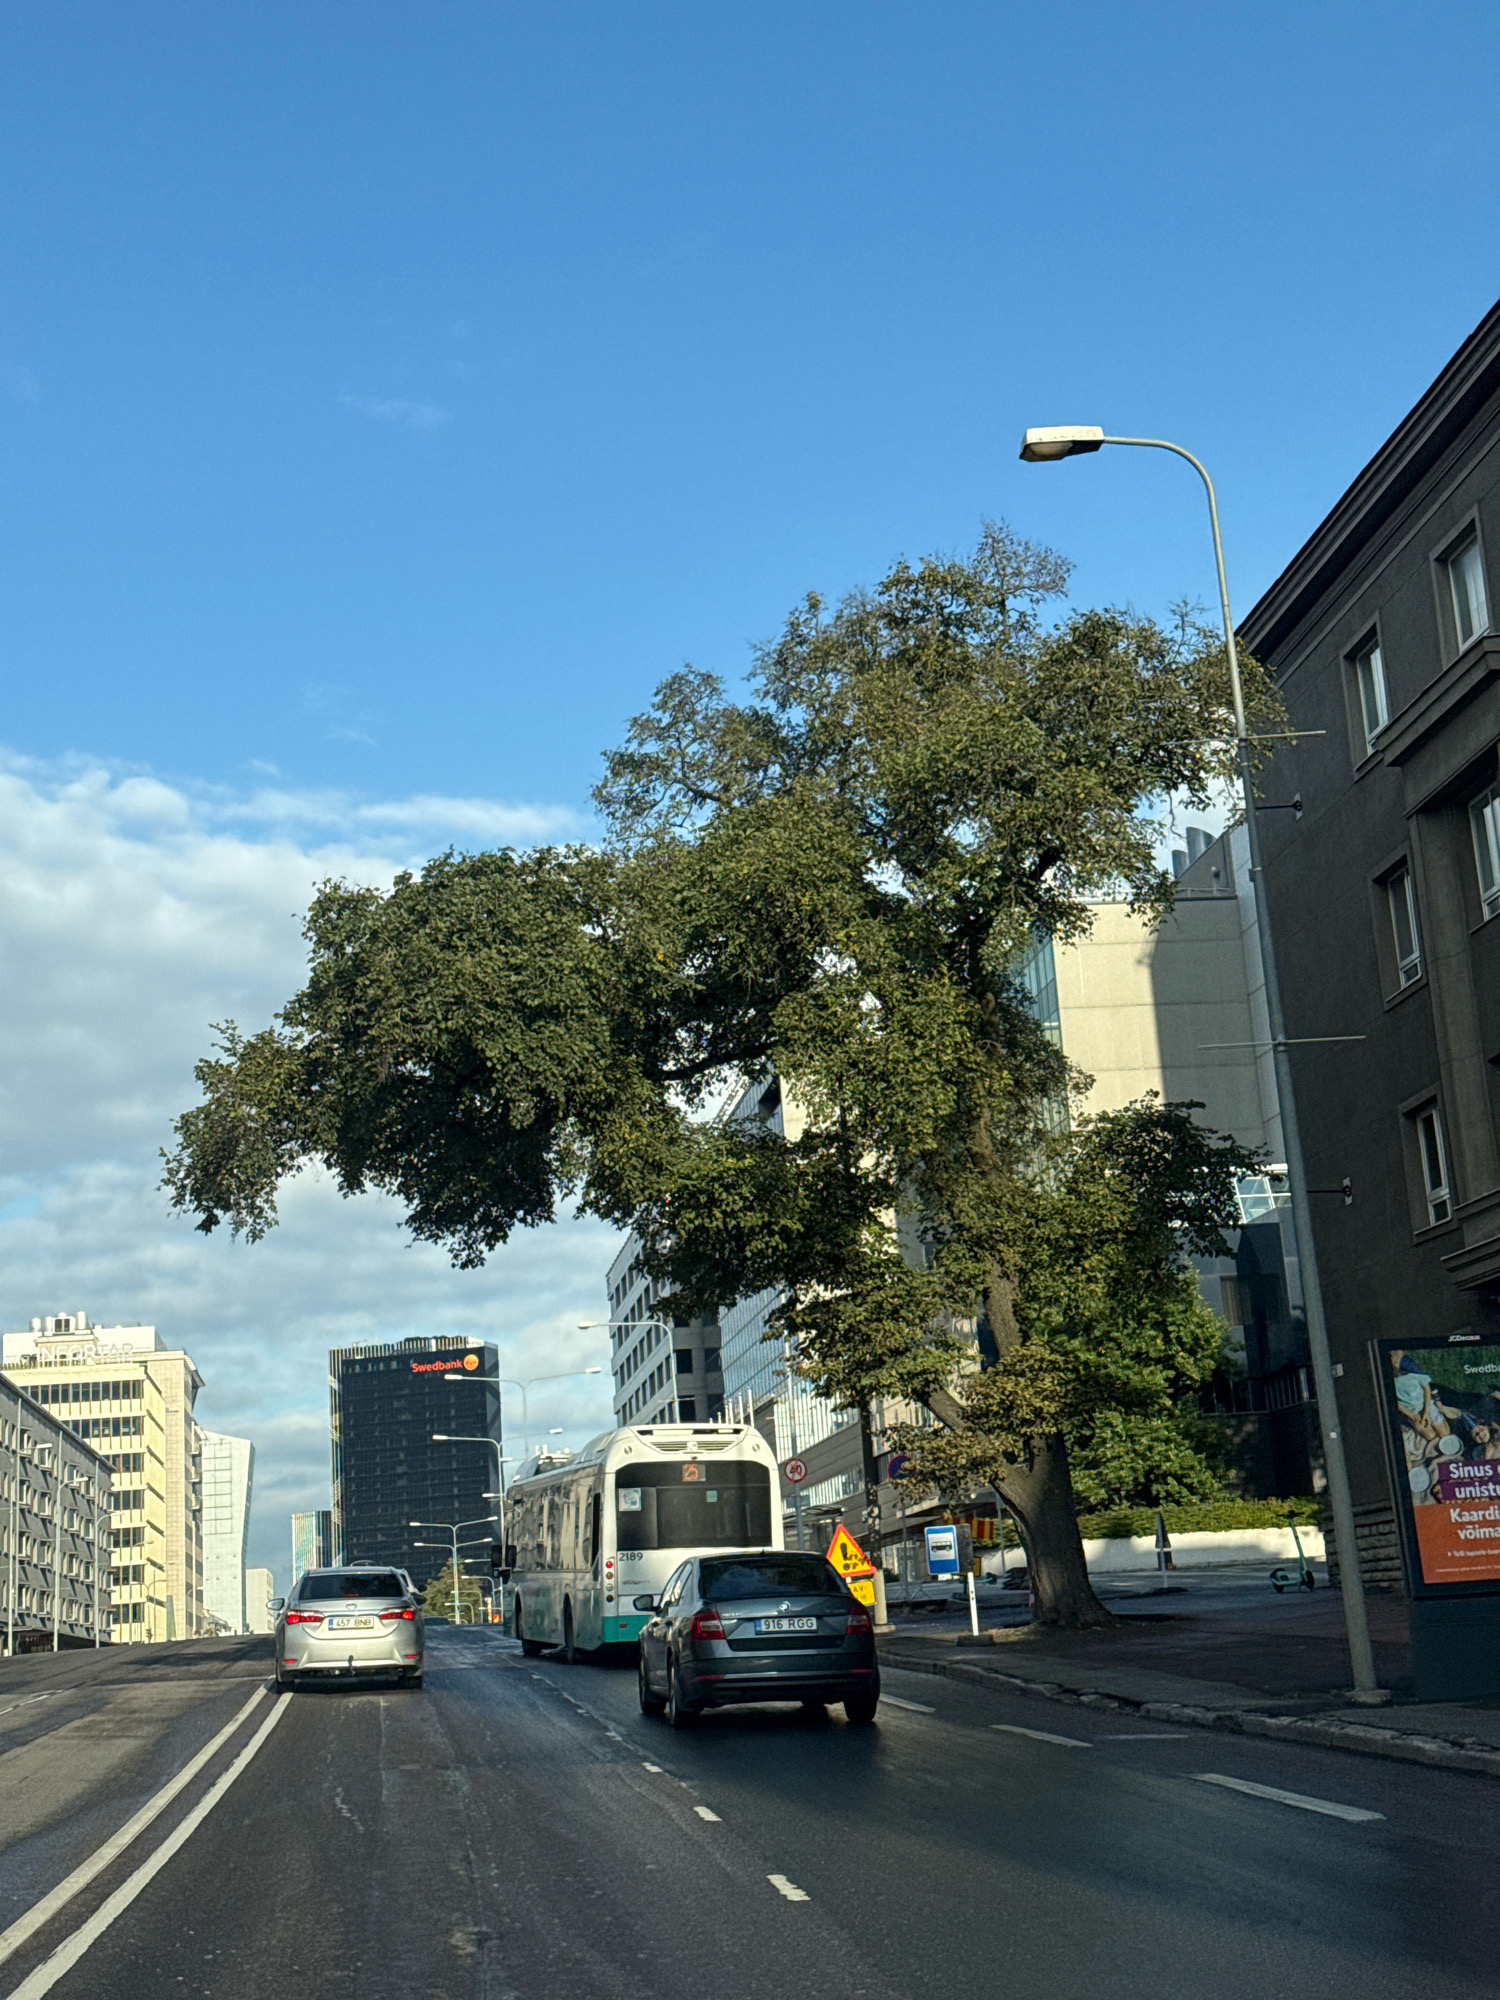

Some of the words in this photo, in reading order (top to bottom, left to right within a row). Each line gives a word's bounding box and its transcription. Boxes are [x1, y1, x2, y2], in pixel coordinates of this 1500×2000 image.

[411, 1359, 463, 1373] Swedbank
[684, 1464, 699, 1480] 25
[1449, 1462, 1493, 1479] Sinus
[618, 1552, 643, 1562] 2189
[336, 1619, 350, 1627] 457
[354, 1619, 371, 1627] BNB
[763, 1619, 783, 1630] 916
[787, 1618, 814, 1629] RGG
